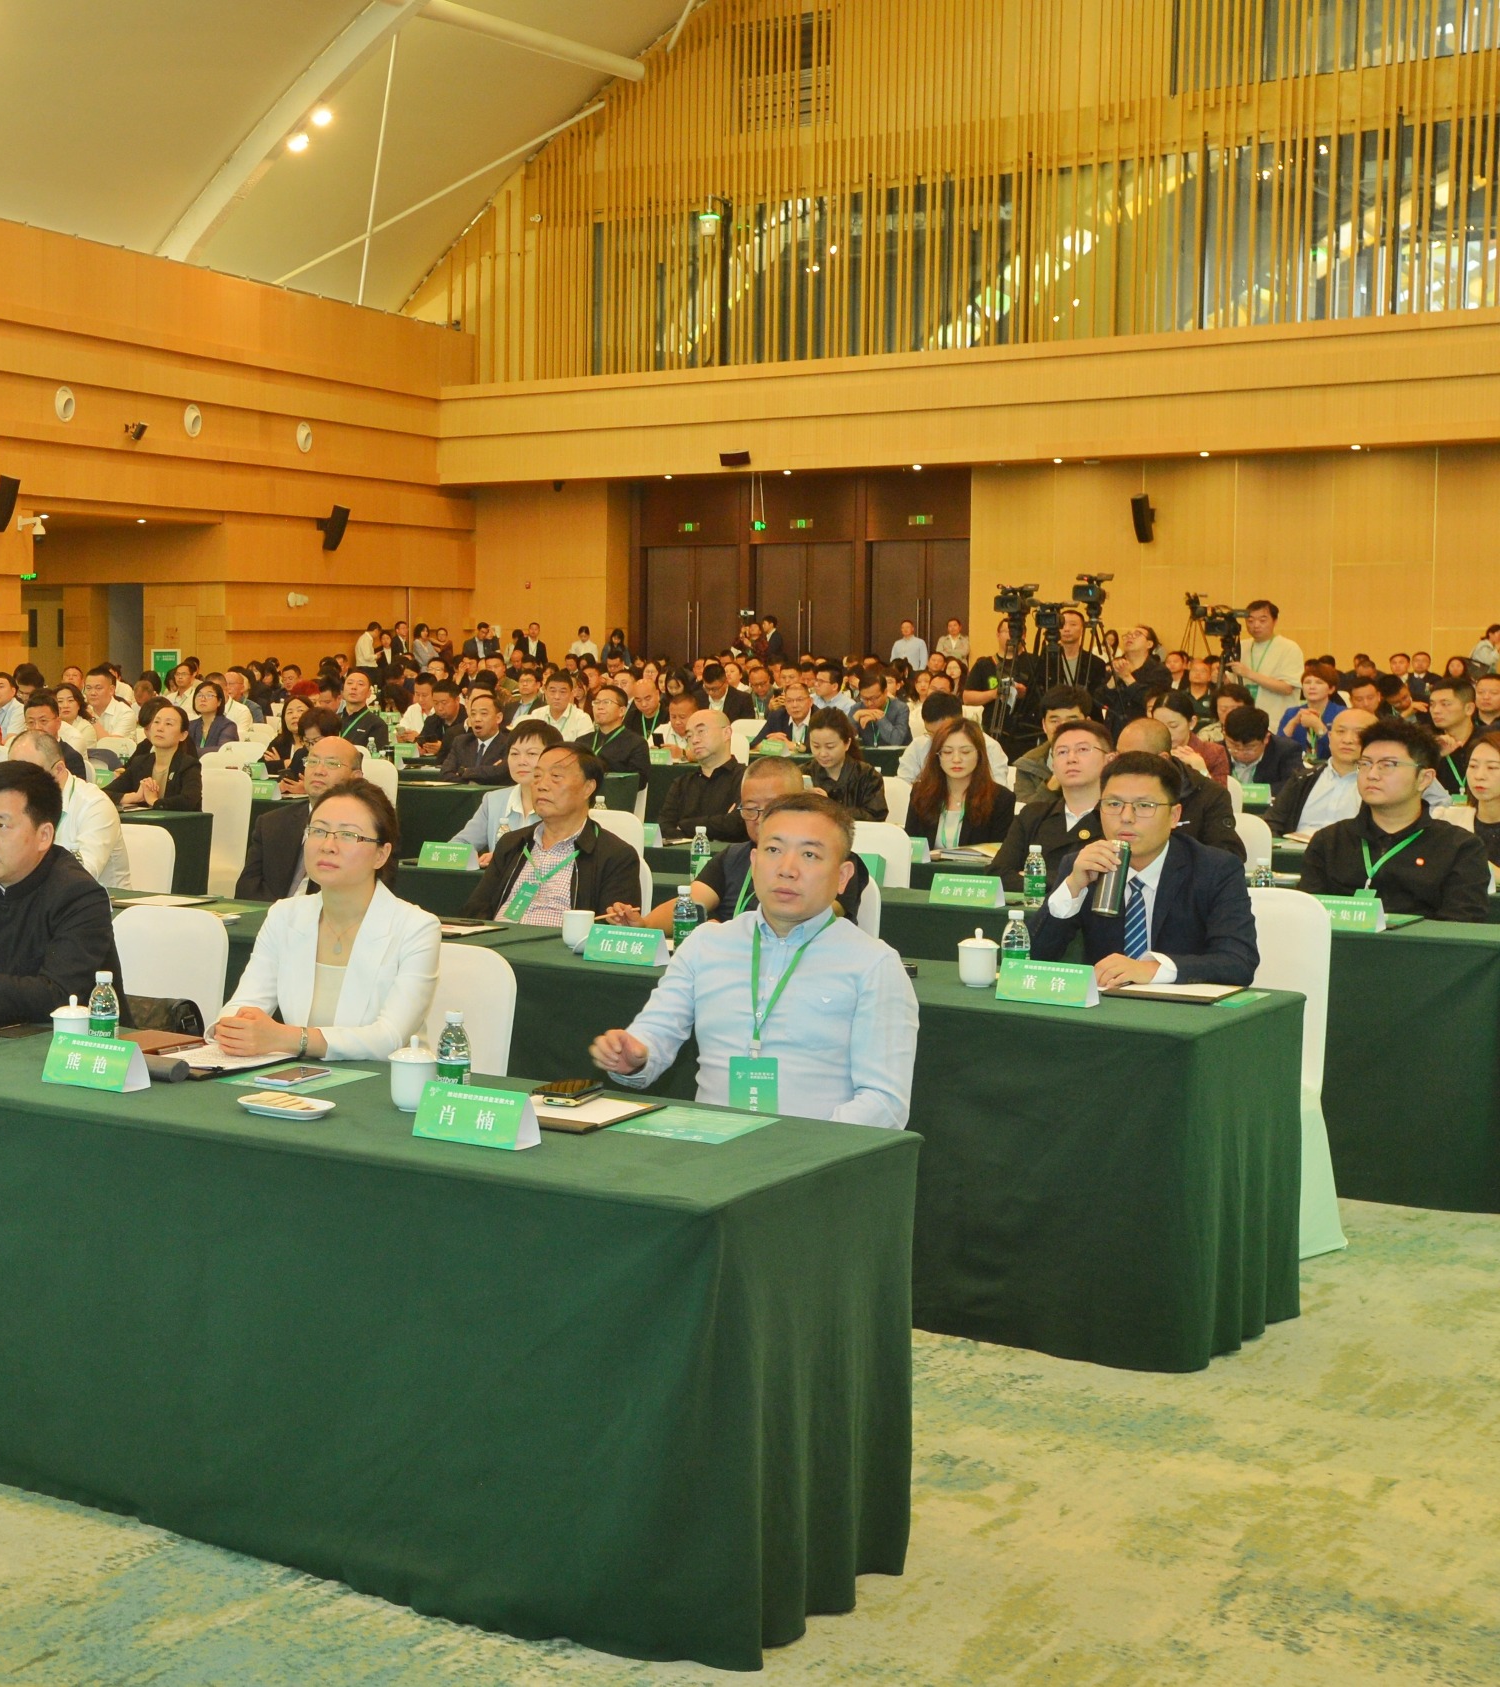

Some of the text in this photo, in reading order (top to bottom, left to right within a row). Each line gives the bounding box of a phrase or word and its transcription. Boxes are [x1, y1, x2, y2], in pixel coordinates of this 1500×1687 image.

[600, 938, 645, 955] 伍建敏
[1023, 974, 1066, 993] 董锋
[65, 1052, 107, 1075] 熊艳
[439, 1104, 496, 1132] 肖楠
